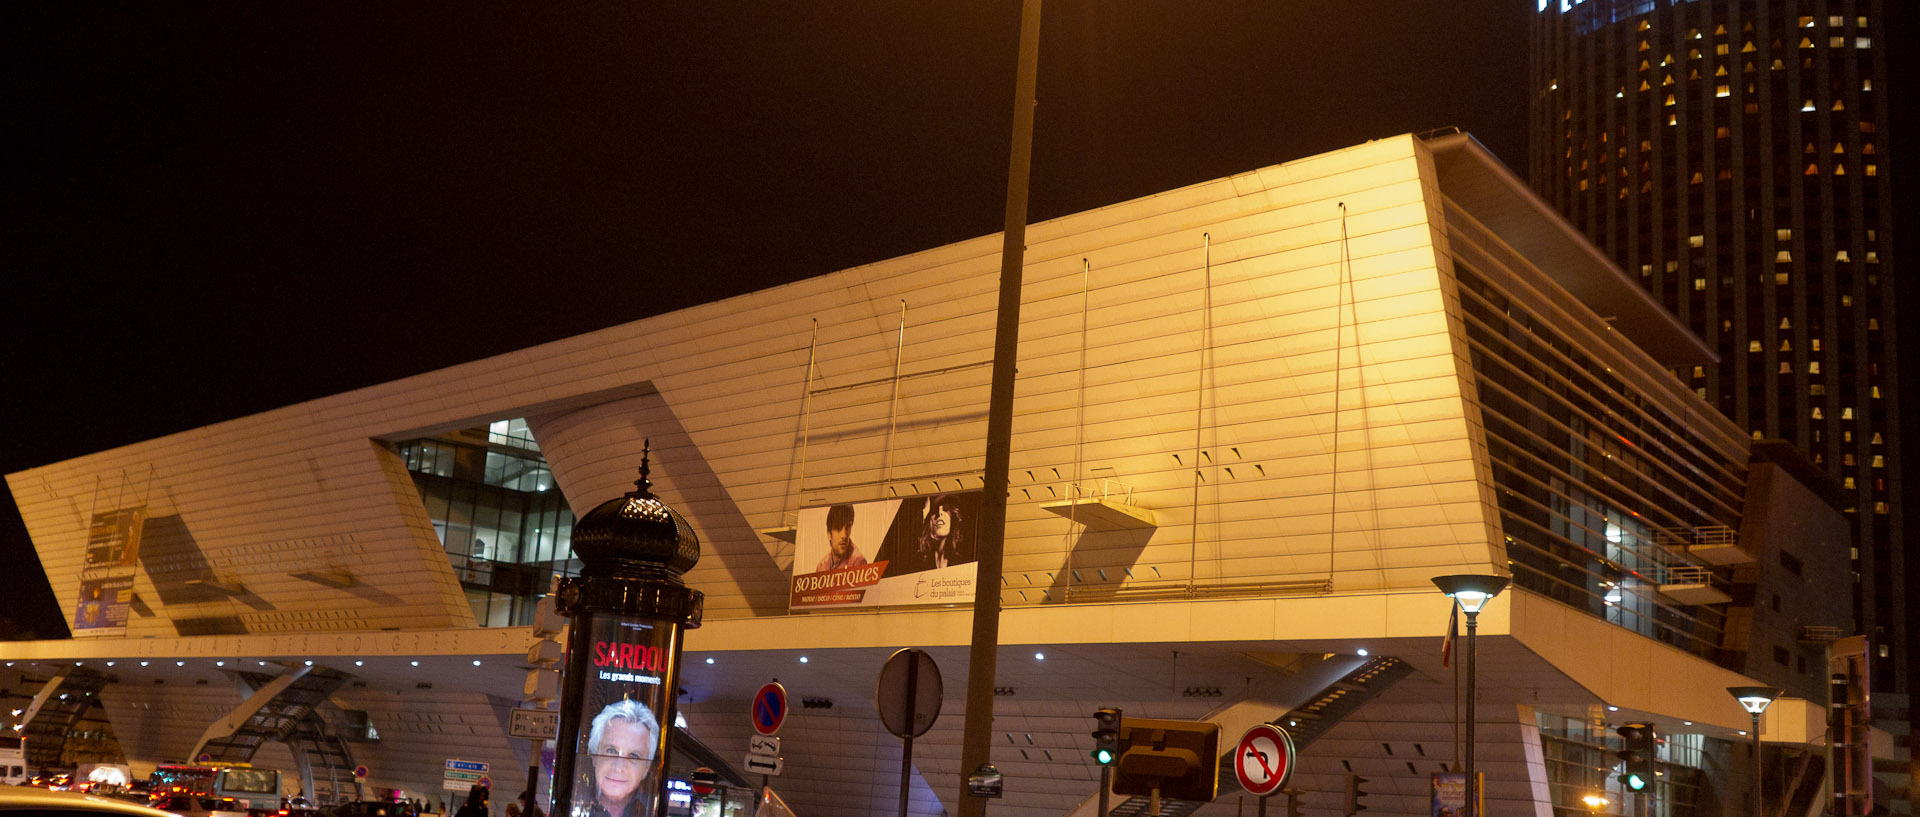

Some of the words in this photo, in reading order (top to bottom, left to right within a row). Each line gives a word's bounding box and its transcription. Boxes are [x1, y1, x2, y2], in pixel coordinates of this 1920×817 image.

[795, 577, 810, 593] 80
[931, 578, 942, 588] Les
[942, 577, 971, 588] boutiques
[930, 589, 939, 598] du
[939, 588, 957, 599] palais
[272, 637, 309, 652] DES
[594, 641, 669, 673] SARDOU
[600, 670, 611, 680] Les
[611, 673, 634, 682] grands
[635, 675, 661, 685] moments
